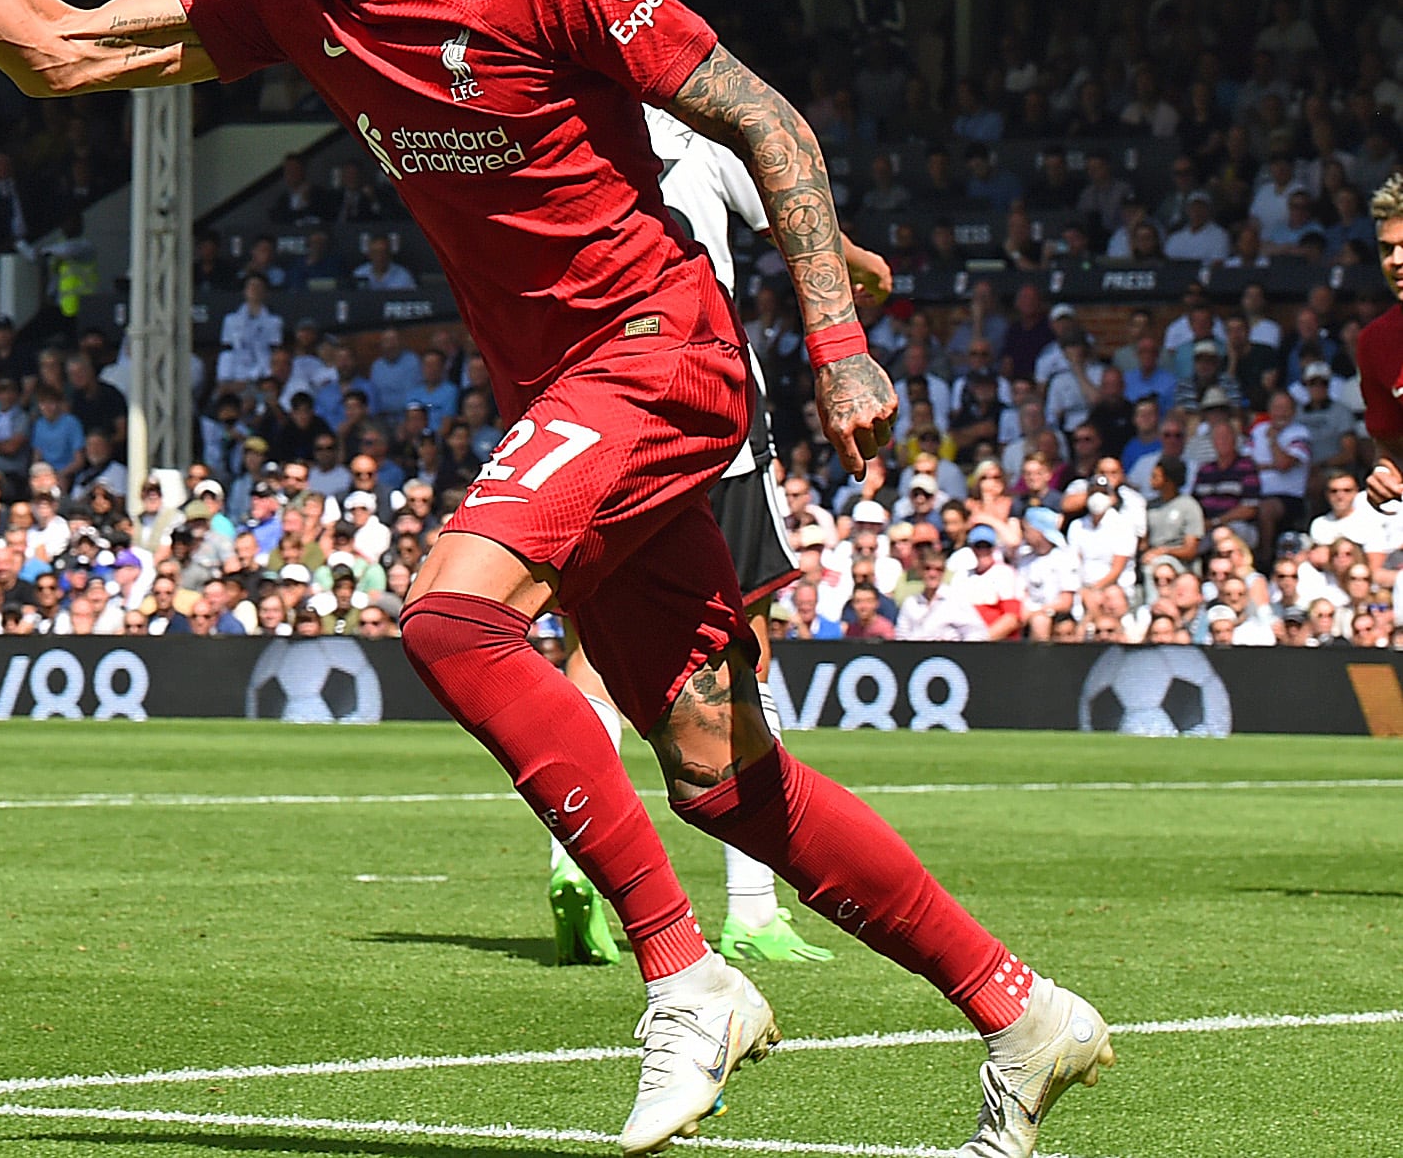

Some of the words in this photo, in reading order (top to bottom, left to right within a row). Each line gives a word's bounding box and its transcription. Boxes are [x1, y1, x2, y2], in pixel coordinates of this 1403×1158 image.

[391, 125, 509, 151] standard
[401, 141, 527, 175] chartered
[1102, 270, 1156, 291] PRESS
[383, 300, 433, 320] PRESS
[473, 418, 602, 492] 27
